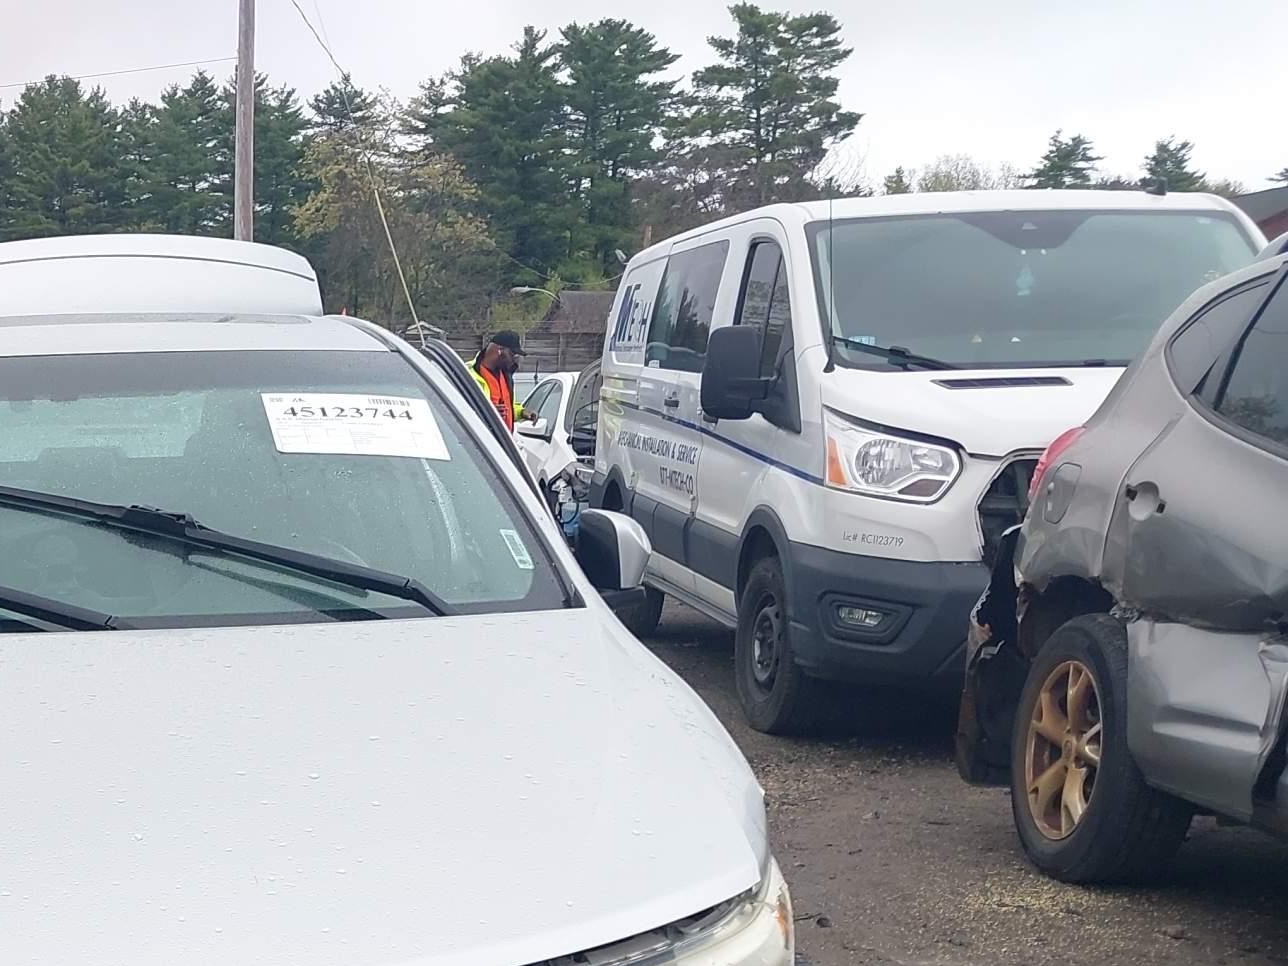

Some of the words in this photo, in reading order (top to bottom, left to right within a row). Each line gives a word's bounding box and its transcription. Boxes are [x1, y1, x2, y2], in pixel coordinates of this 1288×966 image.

[283, 406, 414, 421] 45123744
[676, 443, 698, 465] SERVICE
[861, 533, 904, 547] RC1123719
